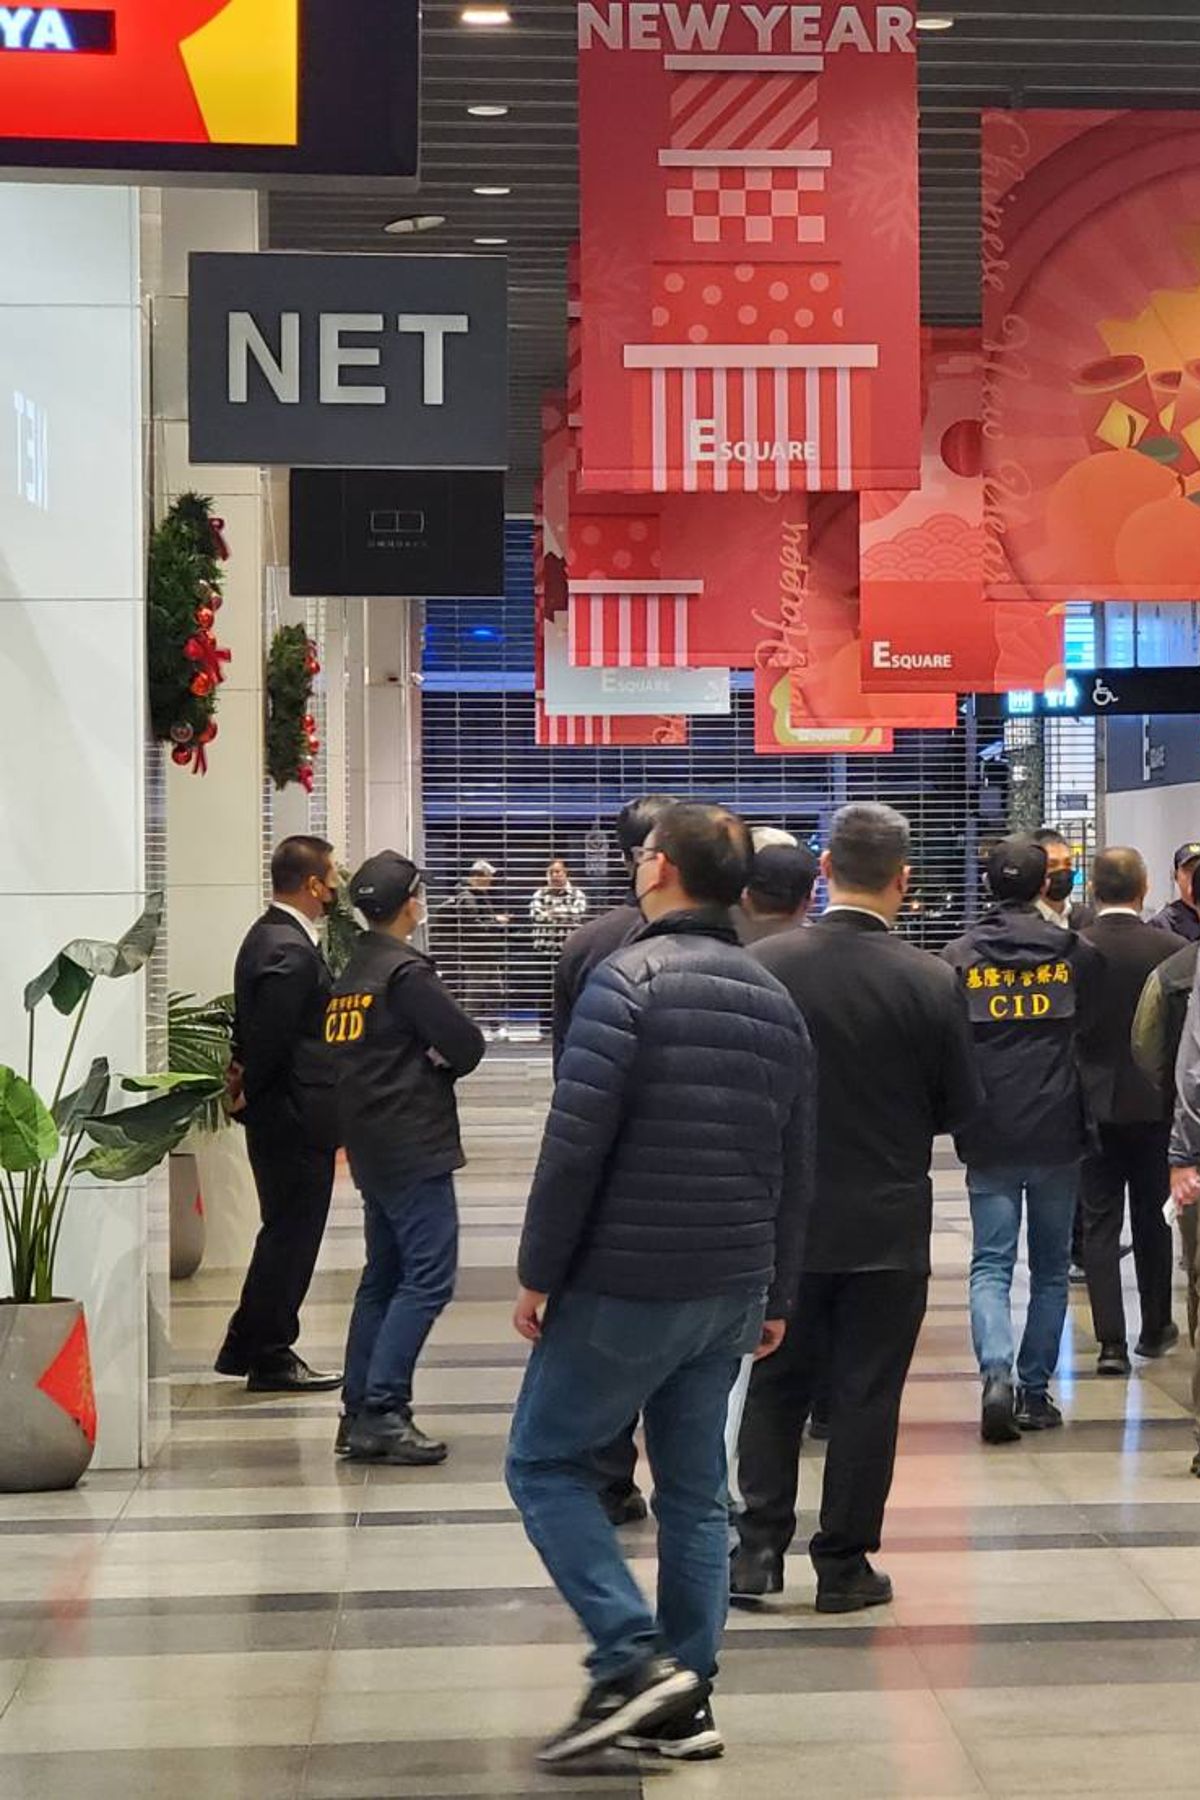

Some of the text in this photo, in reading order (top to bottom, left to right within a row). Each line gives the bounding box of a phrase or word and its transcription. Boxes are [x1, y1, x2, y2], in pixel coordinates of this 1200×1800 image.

[577, 2, 917, 54] NEW YEAR
[227, 311, 469, 406] NET
[690, 418, 817, 462] ESQUARE
[873, 641, 952, 669] ESQUARE
[989, 993, 1051, 1018] CID
[325, 1009, 364, 1043] CID
